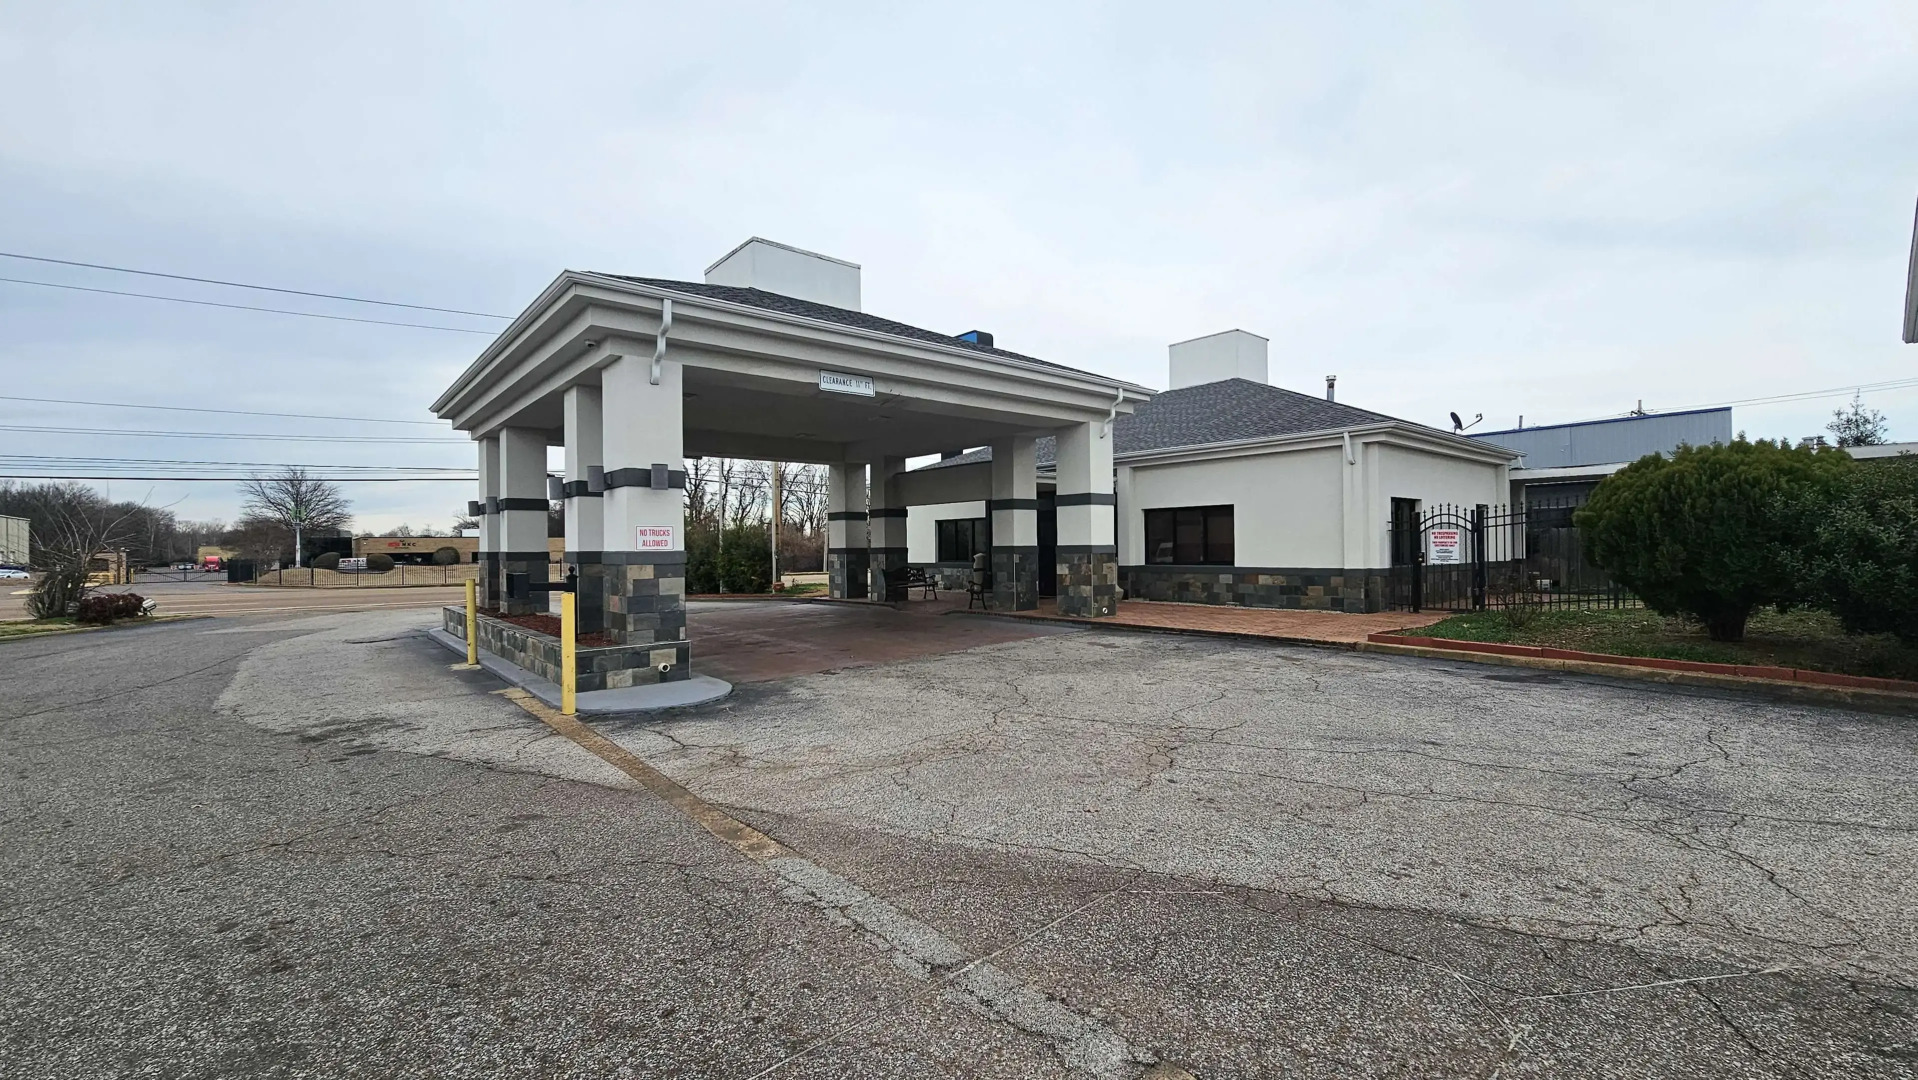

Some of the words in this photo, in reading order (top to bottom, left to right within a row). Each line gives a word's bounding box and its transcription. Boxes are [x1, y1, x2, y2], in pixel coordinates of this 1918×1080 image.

[822, 375, 853, 387] CLEARANCE
[640, 529, 647, 537] NO
[648, 529, 670, 537] TRUCKS
[642, 539, 668, 547] ALLOWED
